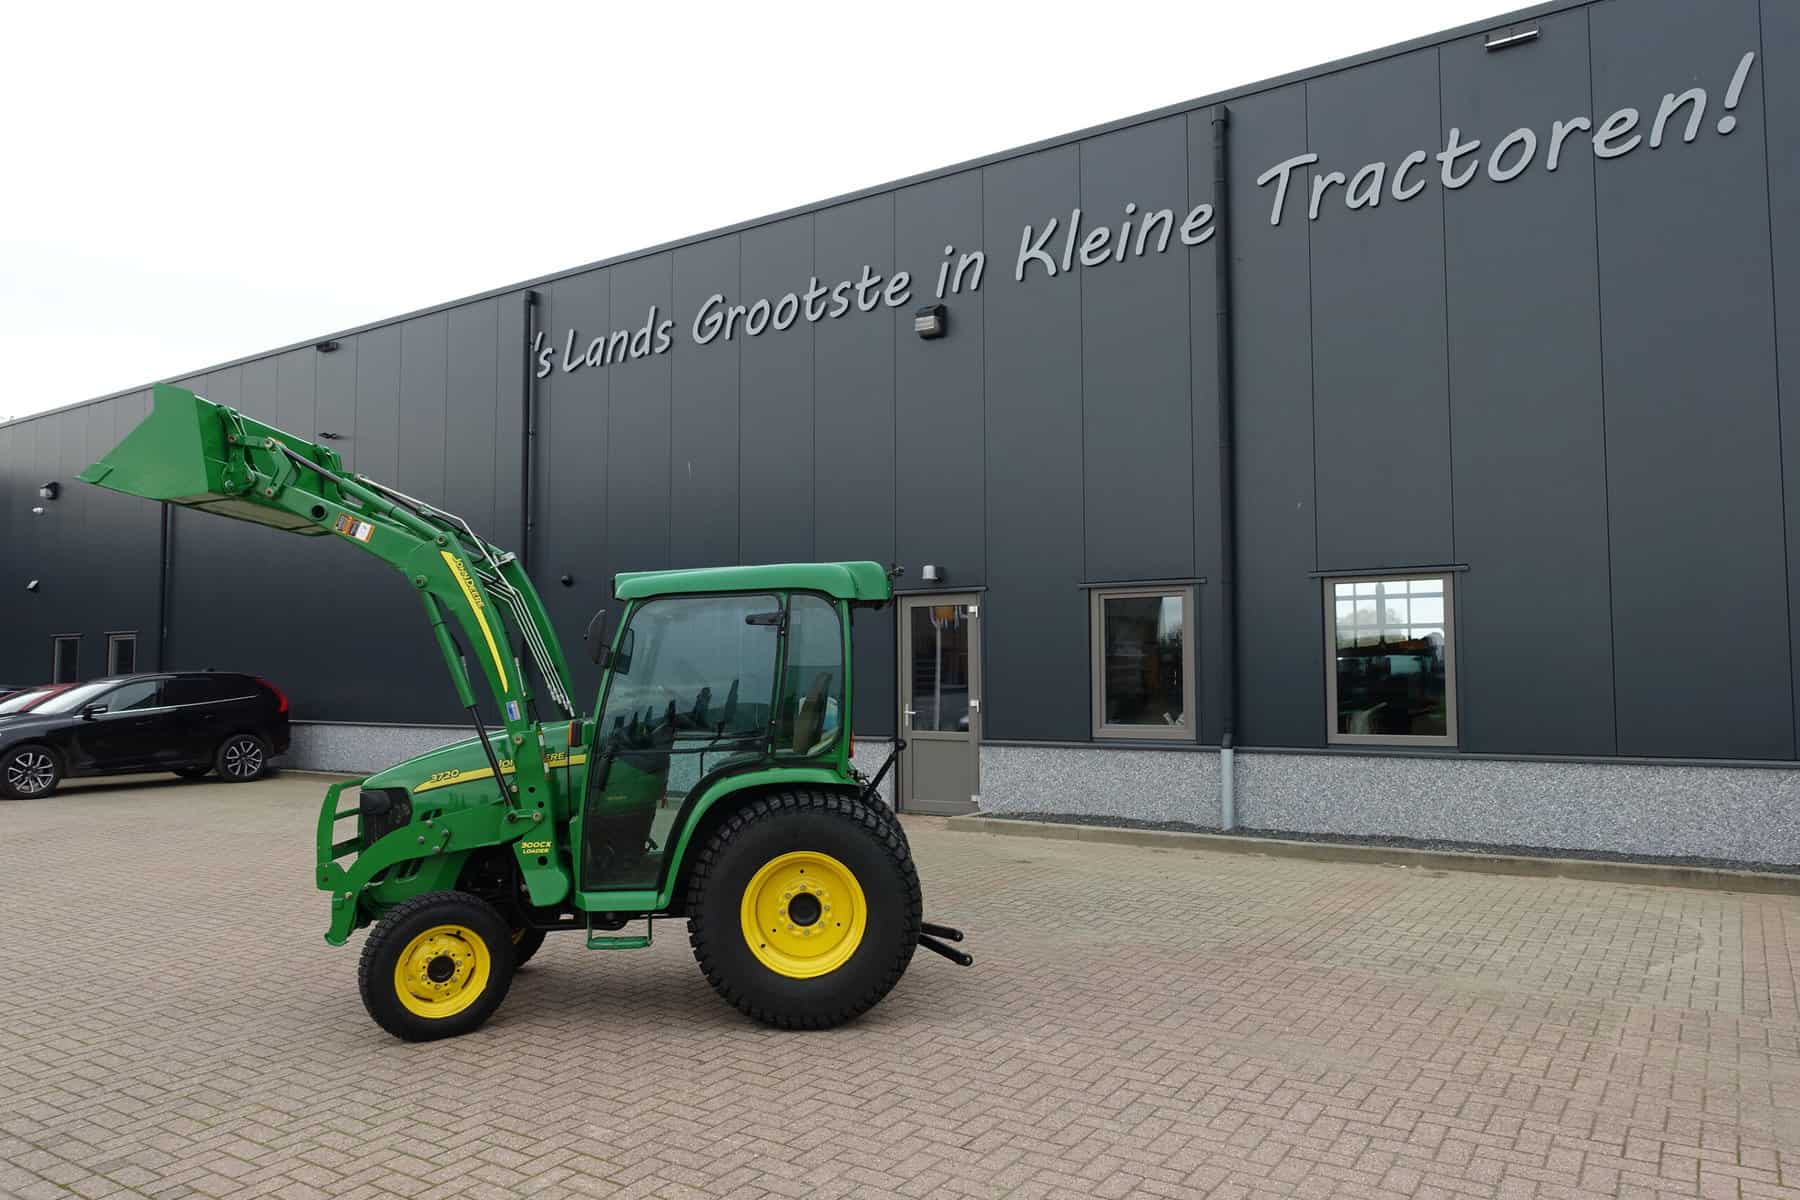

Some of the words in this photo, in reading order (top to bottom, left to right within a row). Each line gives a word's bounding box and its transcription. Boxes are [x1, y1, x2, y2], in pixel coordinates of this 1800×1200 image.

[534, 331, 554, 378] 's
[561, 304, 673, 374] Lands
[691, 264, 912, 345] Grootste
[935, 244, 985, 299] in
[1015, 201, 1215, 282] Kleine
[1256, 51, 1755, 225] Tractoren!
[431, 769, 460, 783] 3720
